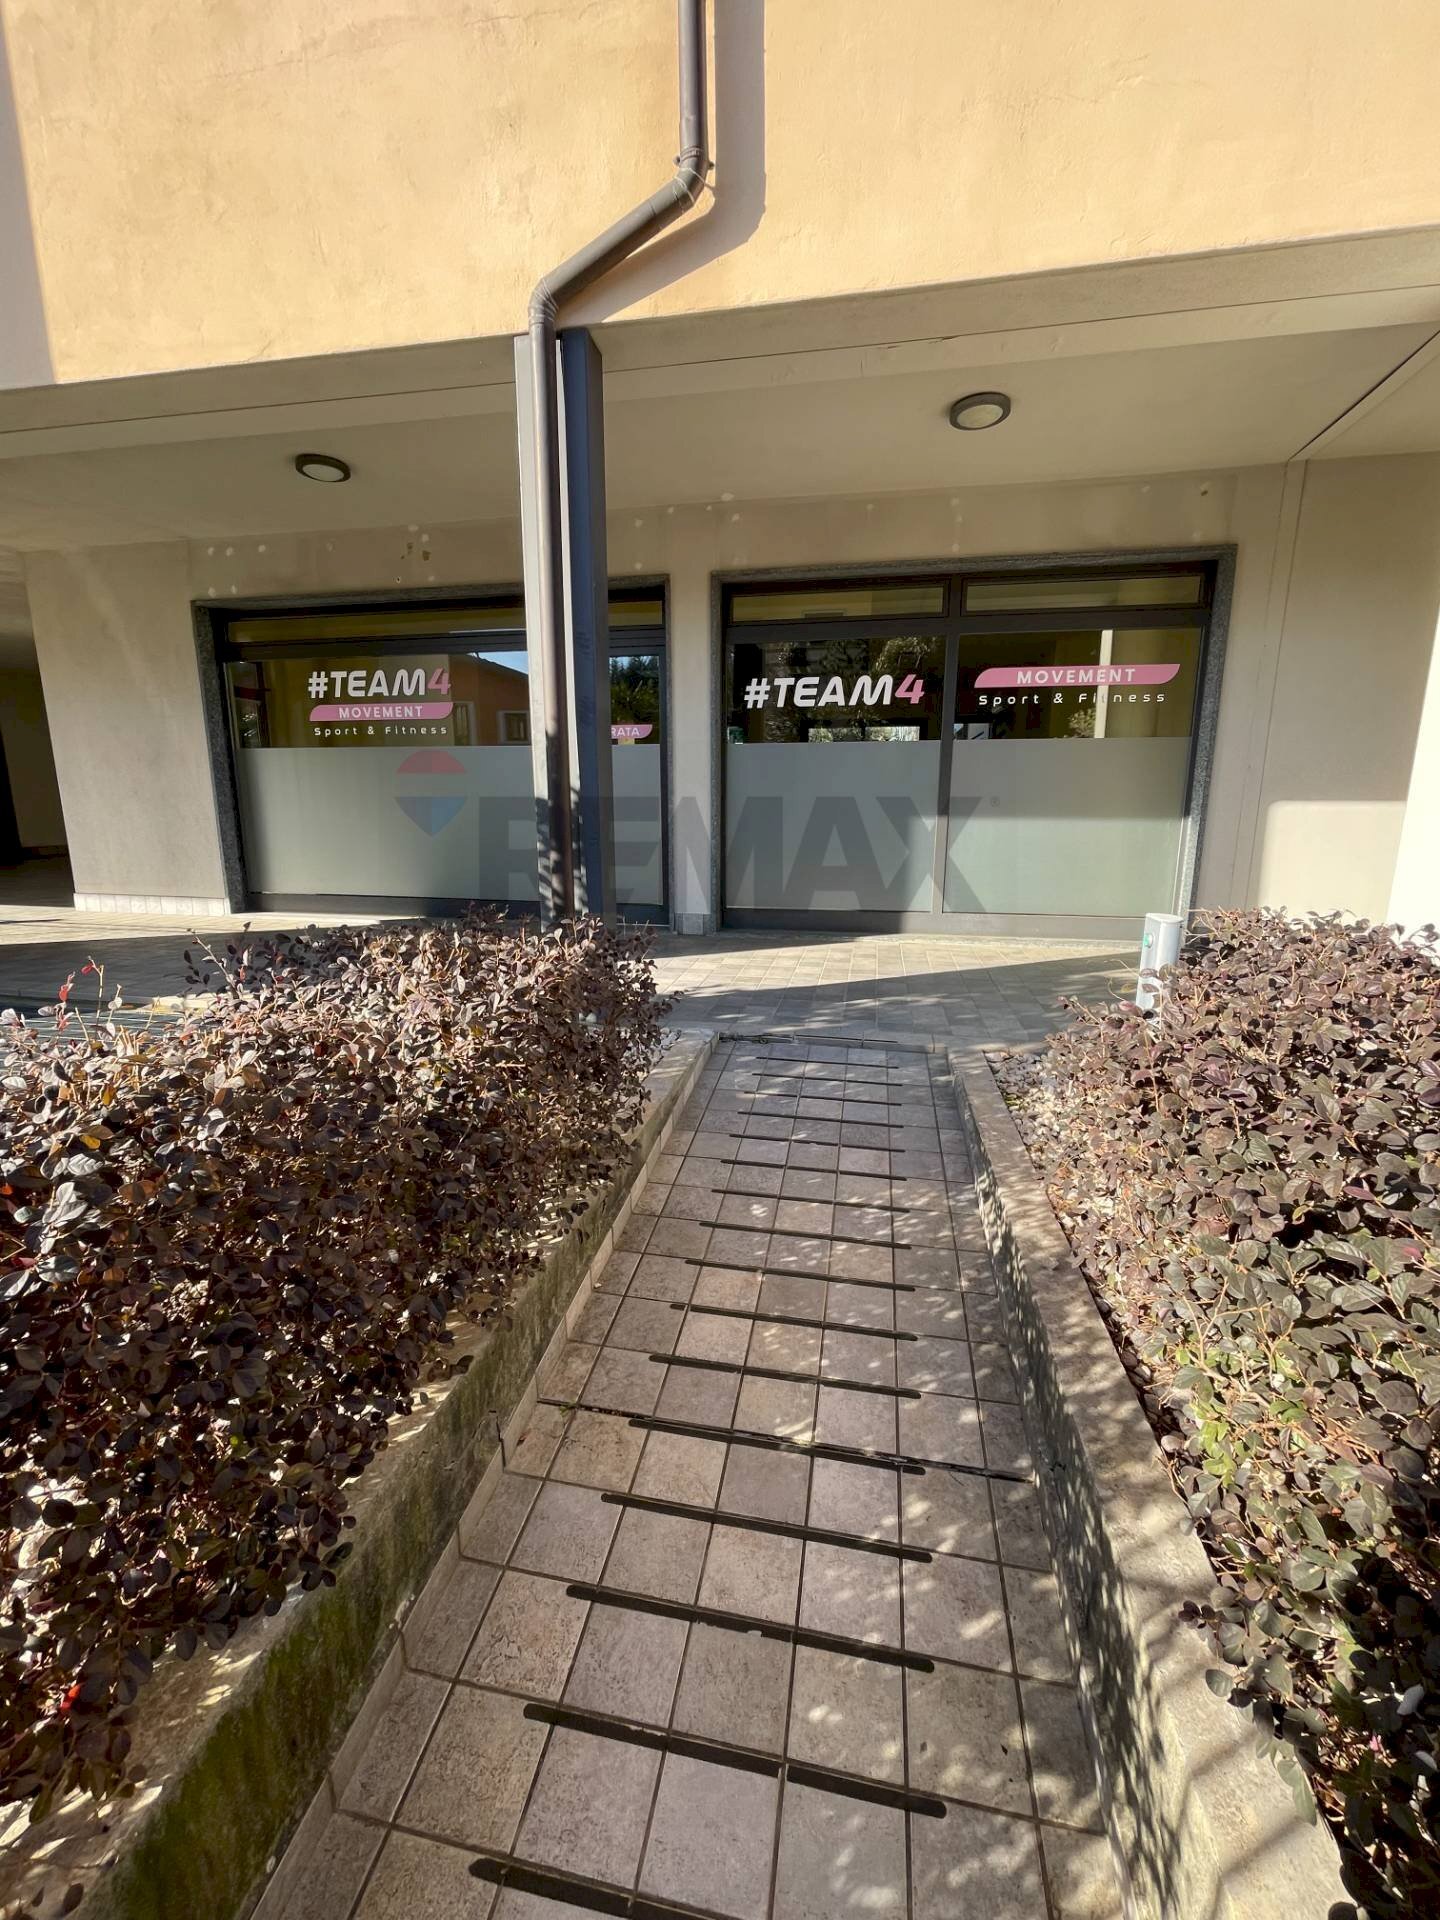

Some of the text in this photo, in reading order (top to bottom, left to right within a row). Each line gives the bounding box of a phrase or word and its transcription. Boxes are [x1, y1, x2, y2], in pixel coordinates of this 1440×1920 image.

[308, 667, 452, 699] #TEAM4
[1016, 668, 1136, 684] MOVEMENT
[743, 673, 925, 709] #TEAM4
[978, 694, 1040, 707] Sport
[1053, 692, 1063, 704] &
[338, 705, 423, 719] MOVEMENT
[314, 725, 447, 737] Sport & Fitness
